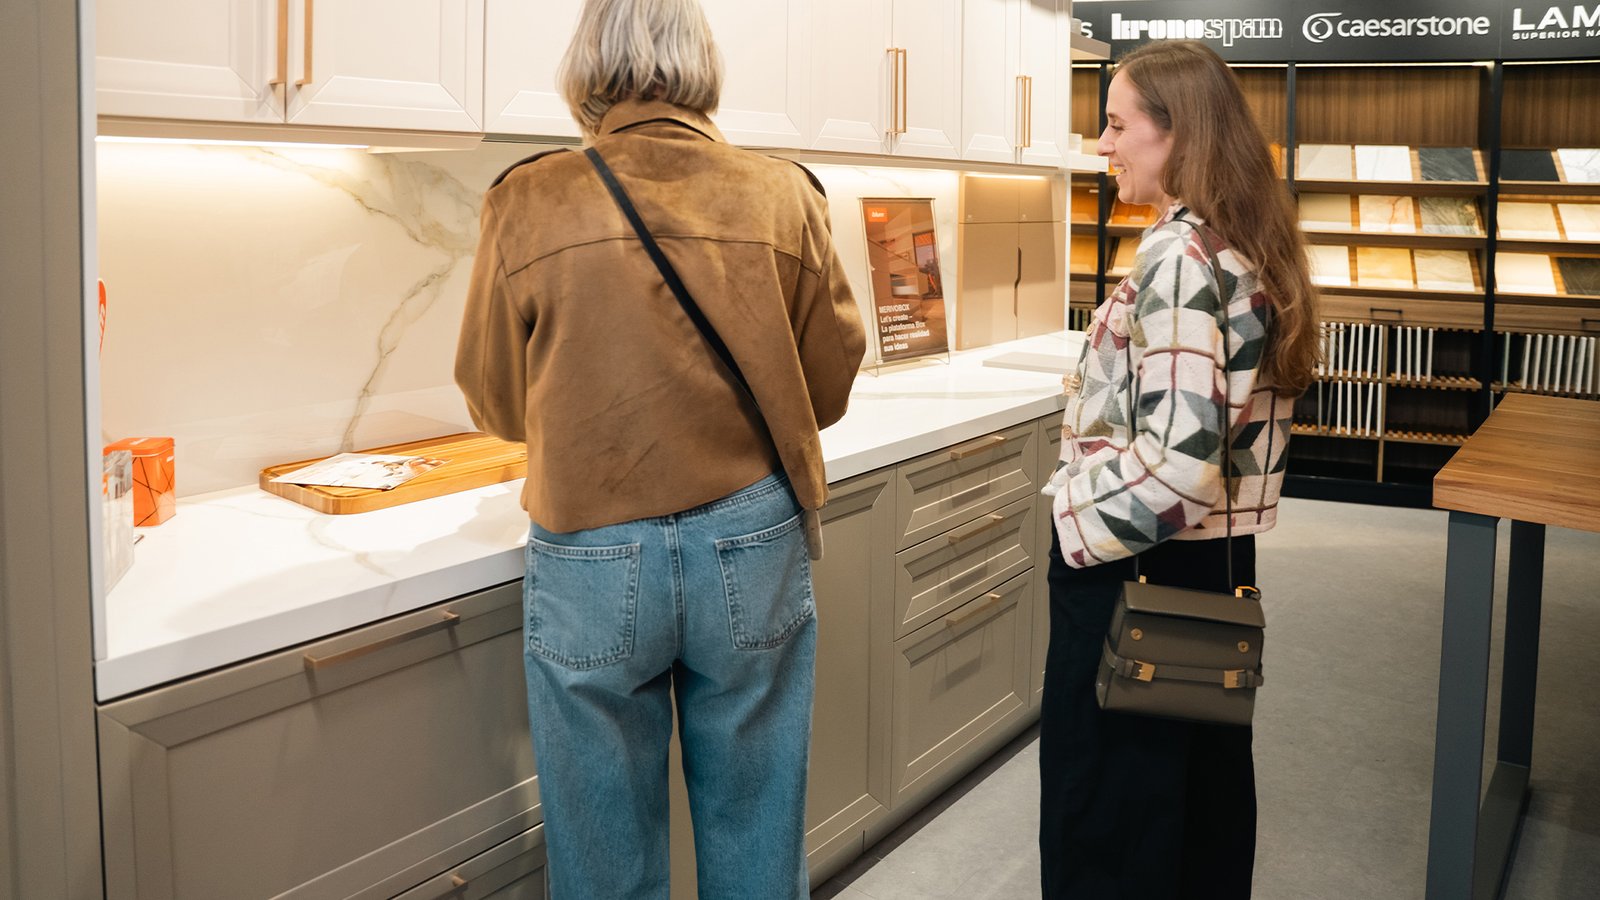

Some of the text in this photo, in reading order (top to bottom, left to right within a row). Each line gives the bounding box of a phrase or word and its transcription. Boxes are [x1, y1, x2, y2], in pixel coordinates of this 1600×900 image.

[1513, 4, 1600, 31] LAM
[1111, 13, 1283, 46] kronospan
[1336, 16, 1490, 37] caesarstone
[1512, 30, 1580, 40] SUPERIOR
[892, 314, 909, 322] create
[888, 323, 915, 333] plataforma
[882, 335, 894, 344] para
[909, 329, 929, 338] realidad
